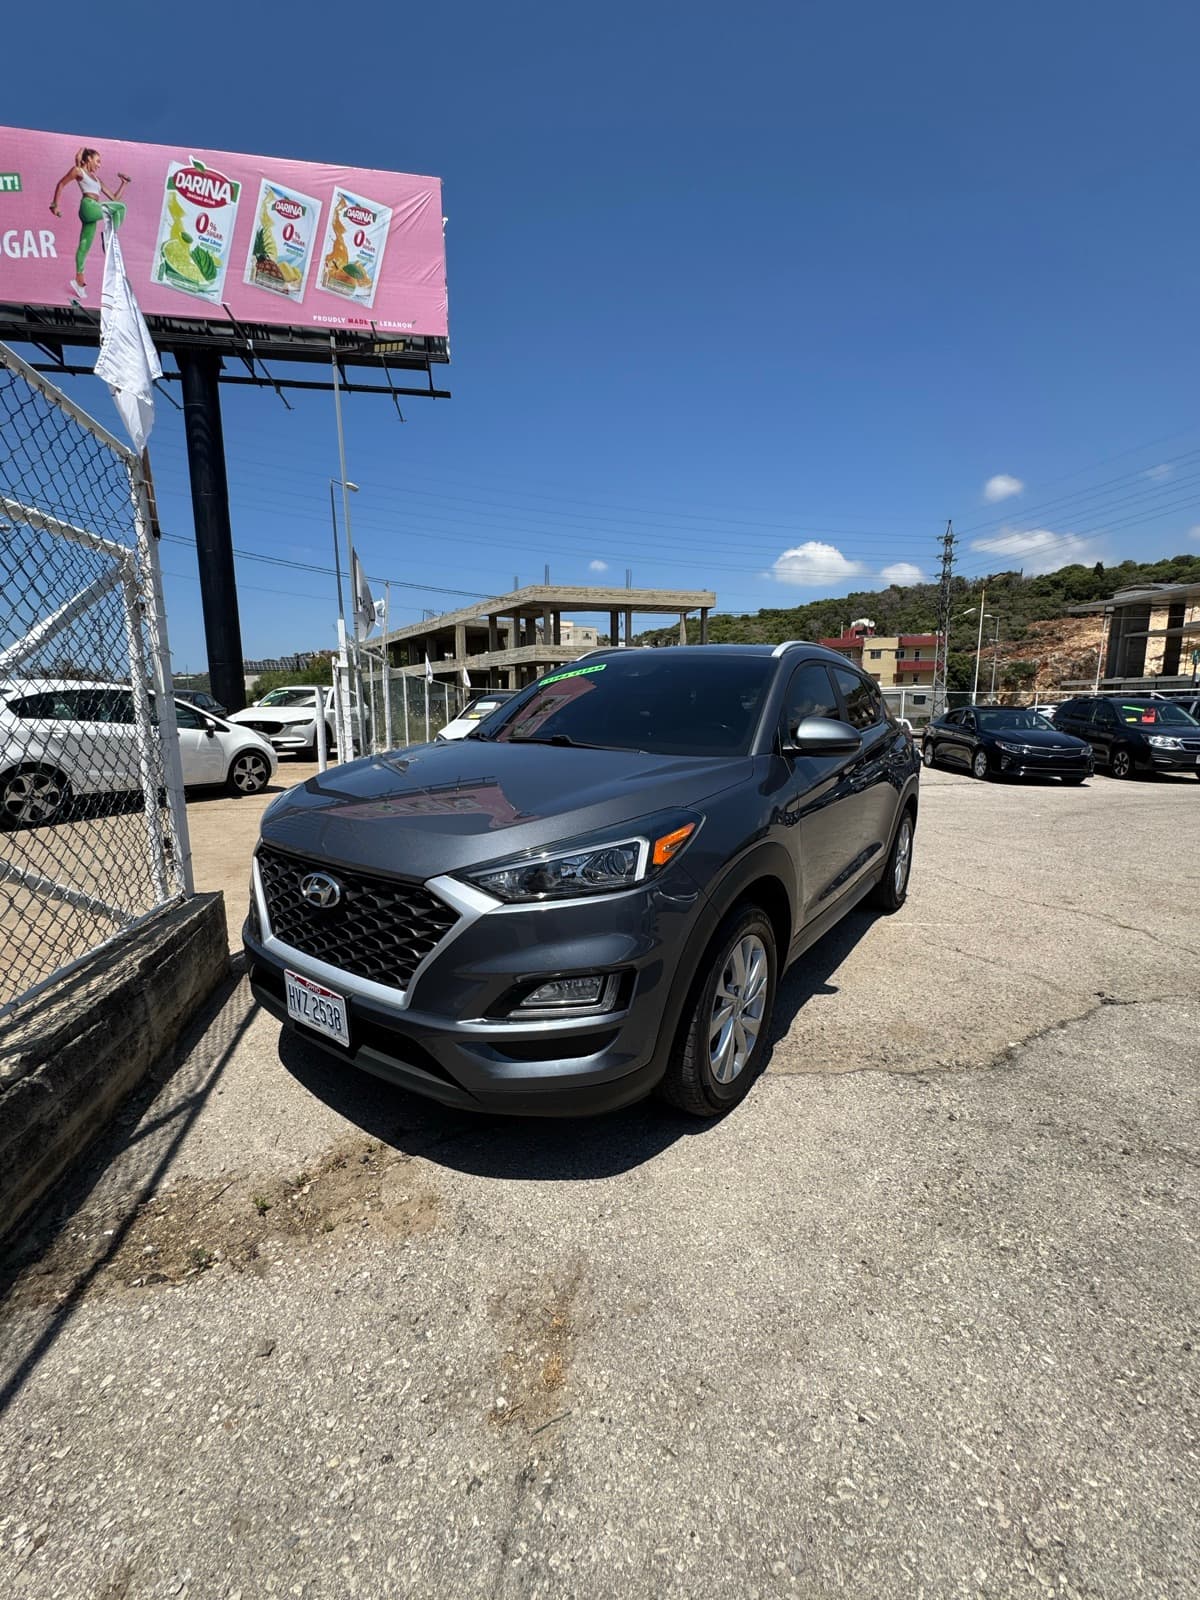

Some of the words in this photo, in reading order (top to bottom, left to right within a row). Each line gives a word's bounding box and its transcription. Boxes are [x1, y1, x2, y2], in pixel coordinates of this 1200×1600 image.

[175, 172, 231, 204] DARINA
[275, 202, 303, 217] DARINA
[347, 209, 374, 223] DARINA
[0, 230, 58, 258] GAR
[313, 315, 346, 324] PROUDLY
[380, 320, 413, 329] LEBANON
[312, 995, 342, 1031] 2538
